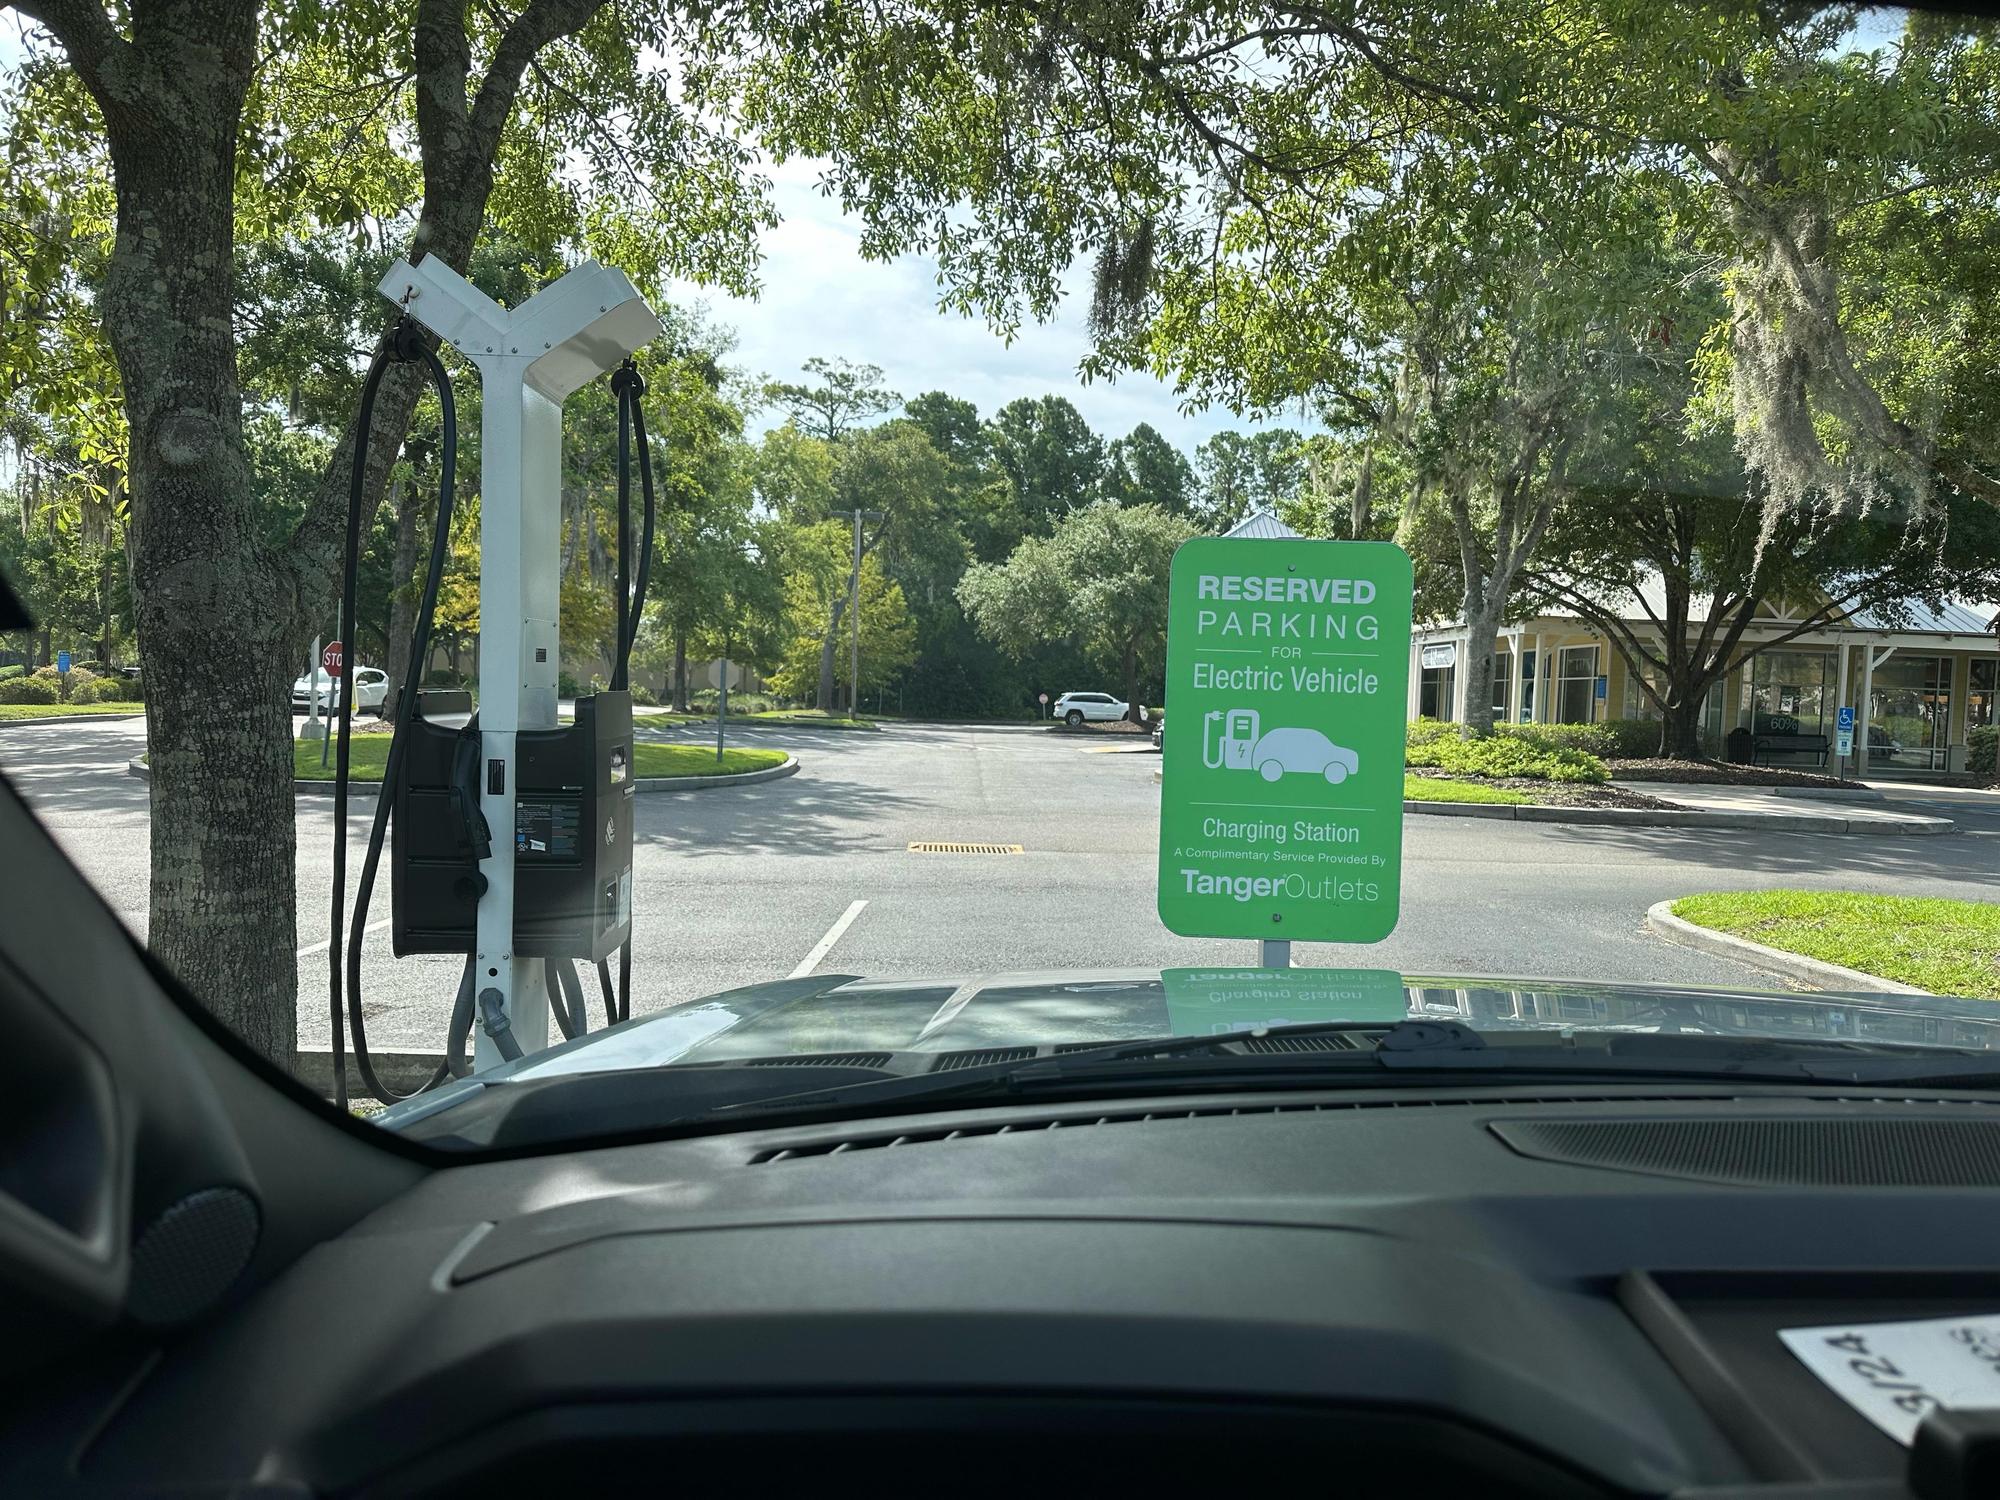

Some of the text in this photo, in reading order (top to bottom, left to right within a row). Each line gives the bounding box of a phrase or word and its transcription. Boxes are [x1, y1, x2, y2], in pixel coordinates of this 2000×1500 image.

[1198, 575, 1376, 604] RESERVED
[1198, 610, 1378, 640] PARKING
[324, 652, 343, 667] STO
[1271, 646, 1301, 659] FOR
[1193, 663, 1378, 694] Electric Vehicle
[1770, 717, 1797, 730] 60%
[1203, 817, 1360, 844] Charging Station
[1174, 847, 1386, 868] A Complimentary Service Provided By
